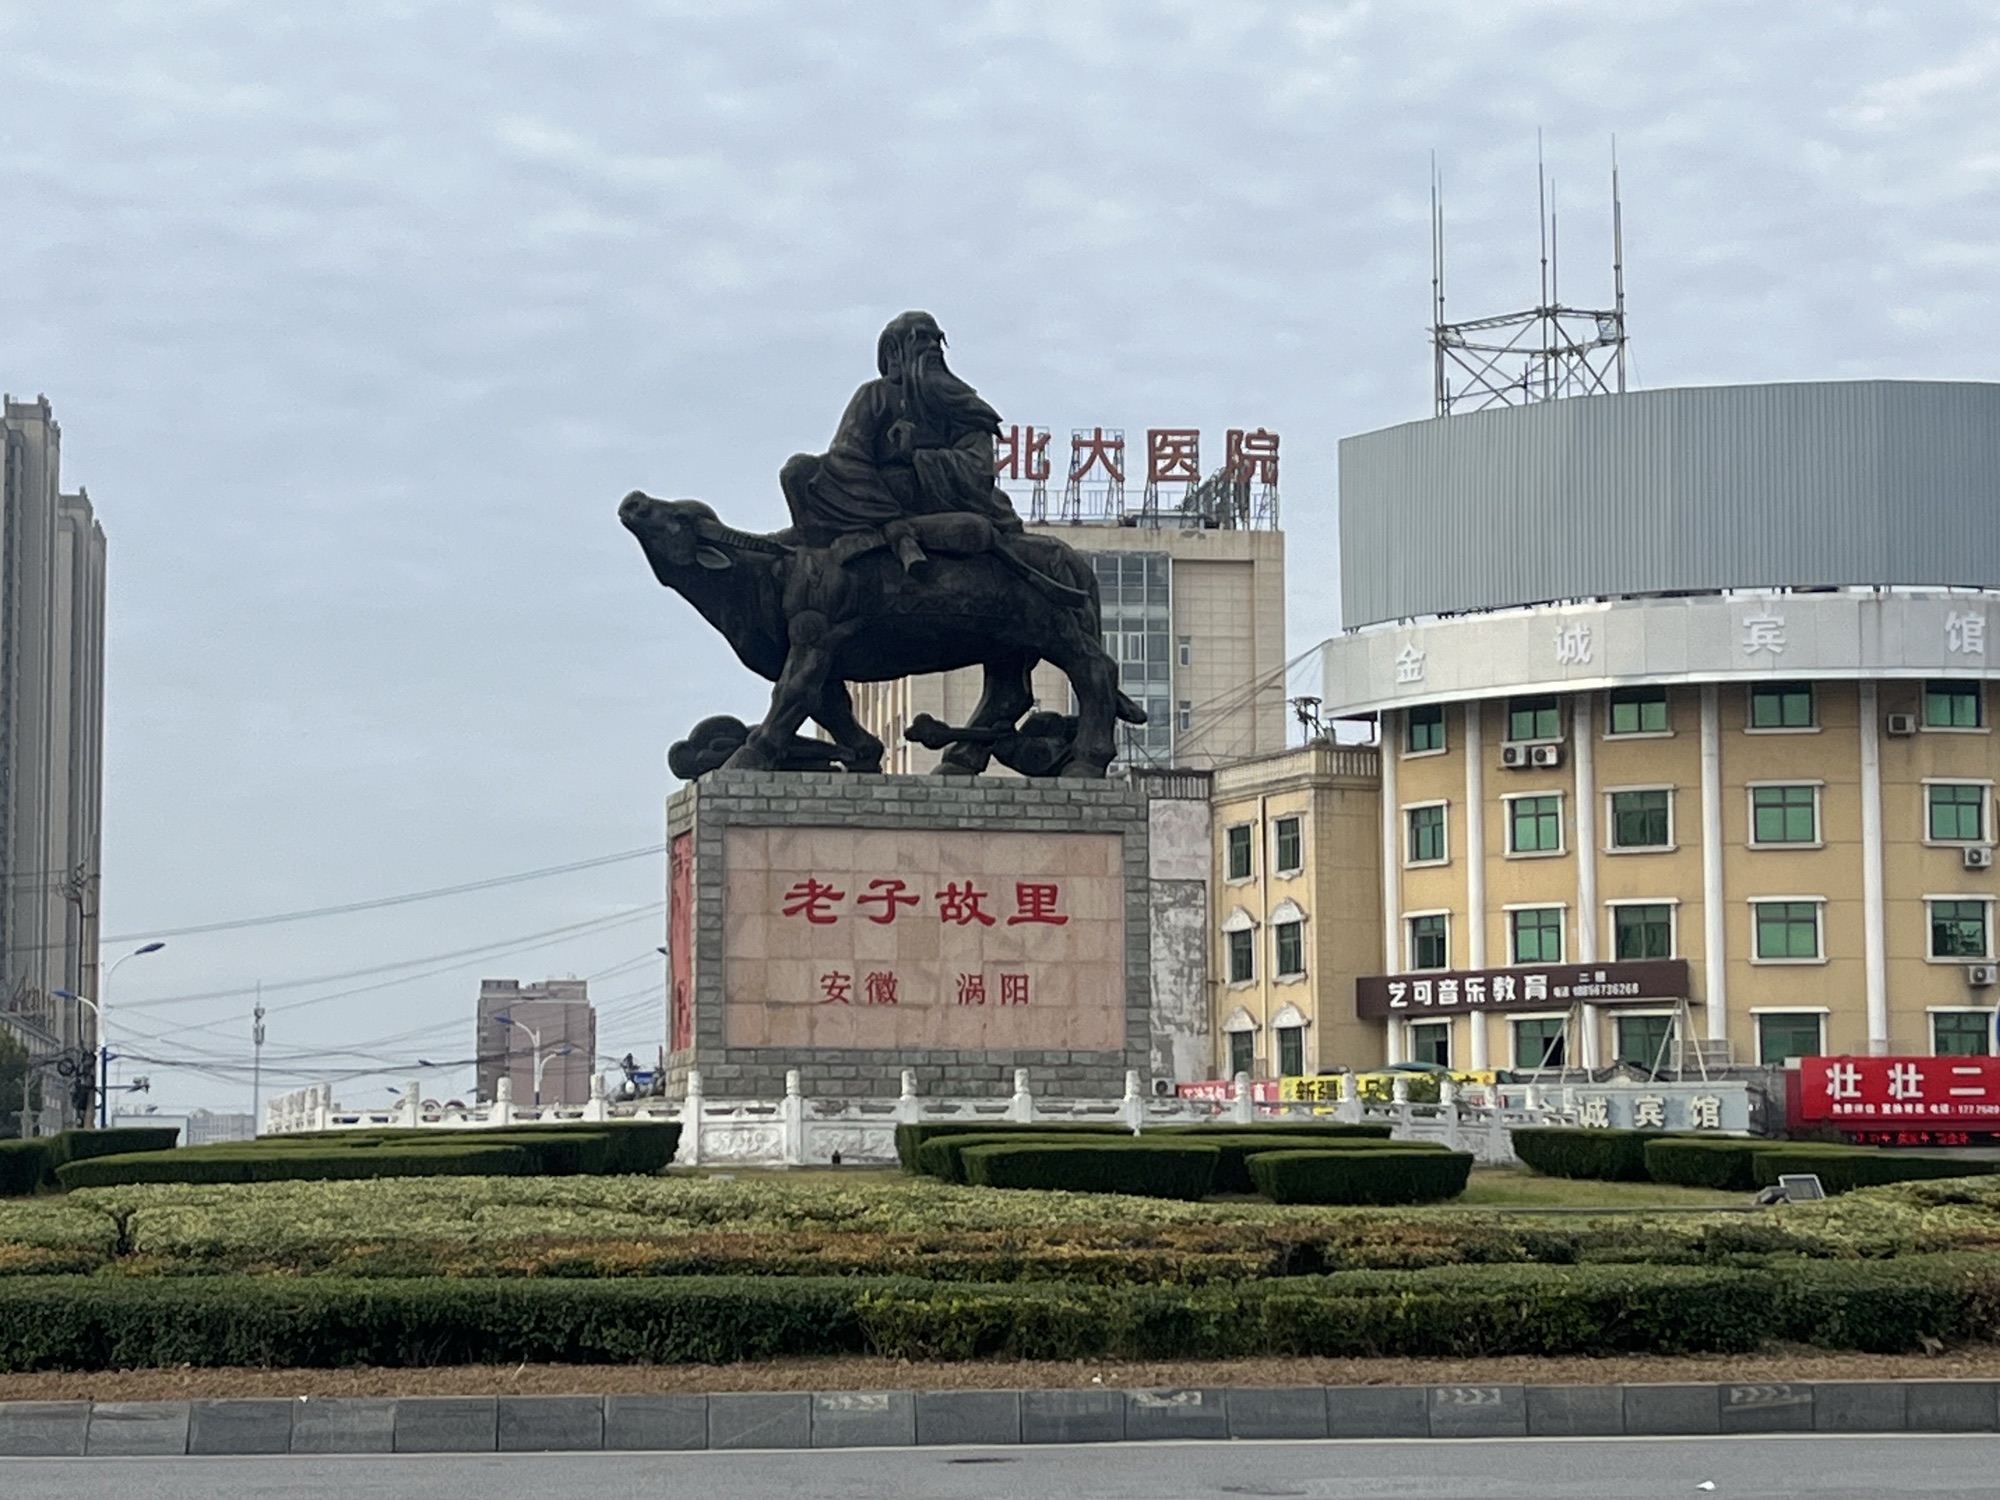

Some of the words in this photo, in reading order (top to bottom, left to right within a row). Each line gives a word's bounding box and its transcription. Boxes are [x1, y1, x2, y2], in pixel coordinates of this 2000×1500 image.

[1395, 610, 1987, 684] 金诚宾馆
[782, 878, 1069, 927] 老子故里
[820, 970, 899, 1005] 安徽
[955, 972, 1030, 1006] 涡阳
[1388, 974, 1548, 1008] 艺可音乐教育
[1825, 1062, 1986, 1100] 壮壮二
